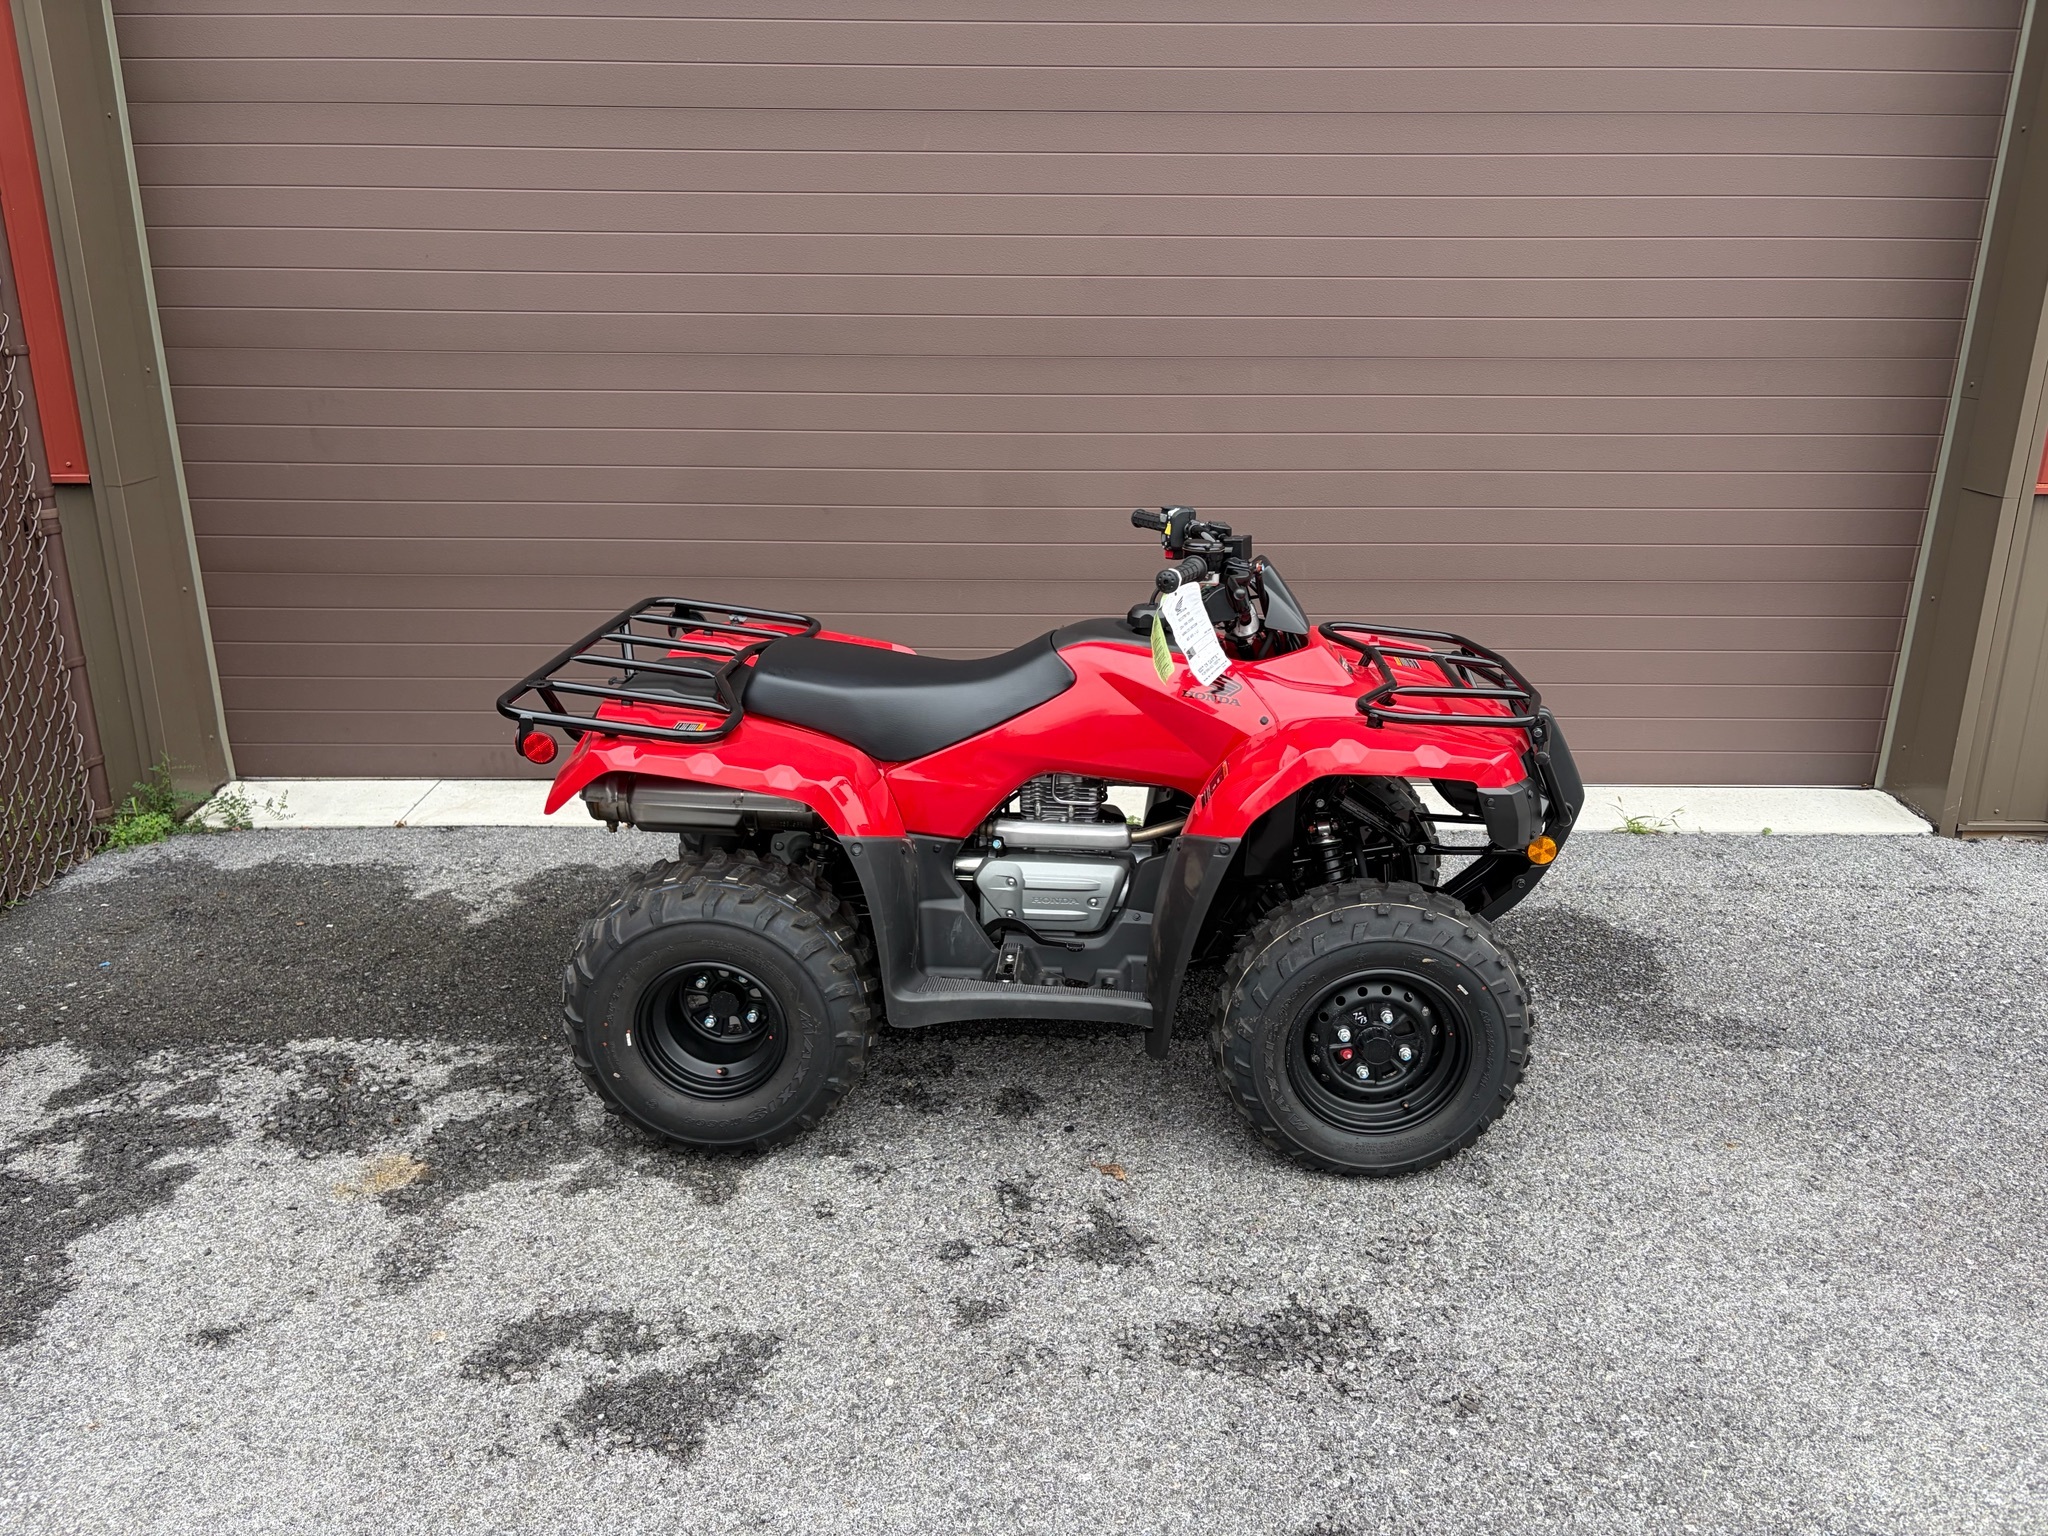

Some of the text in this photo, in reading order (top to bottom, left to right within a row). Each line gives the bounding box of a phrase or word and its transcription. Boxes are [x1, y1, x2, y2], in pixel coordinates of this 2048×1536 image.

[1181, 689, 1242, 708] HONDA
[1031, 896, 1080, 906] HONDA
[747, 1008, 819, 1124] MAXXIS
[1263, 1024, 1311, 1132] MAXXIS
